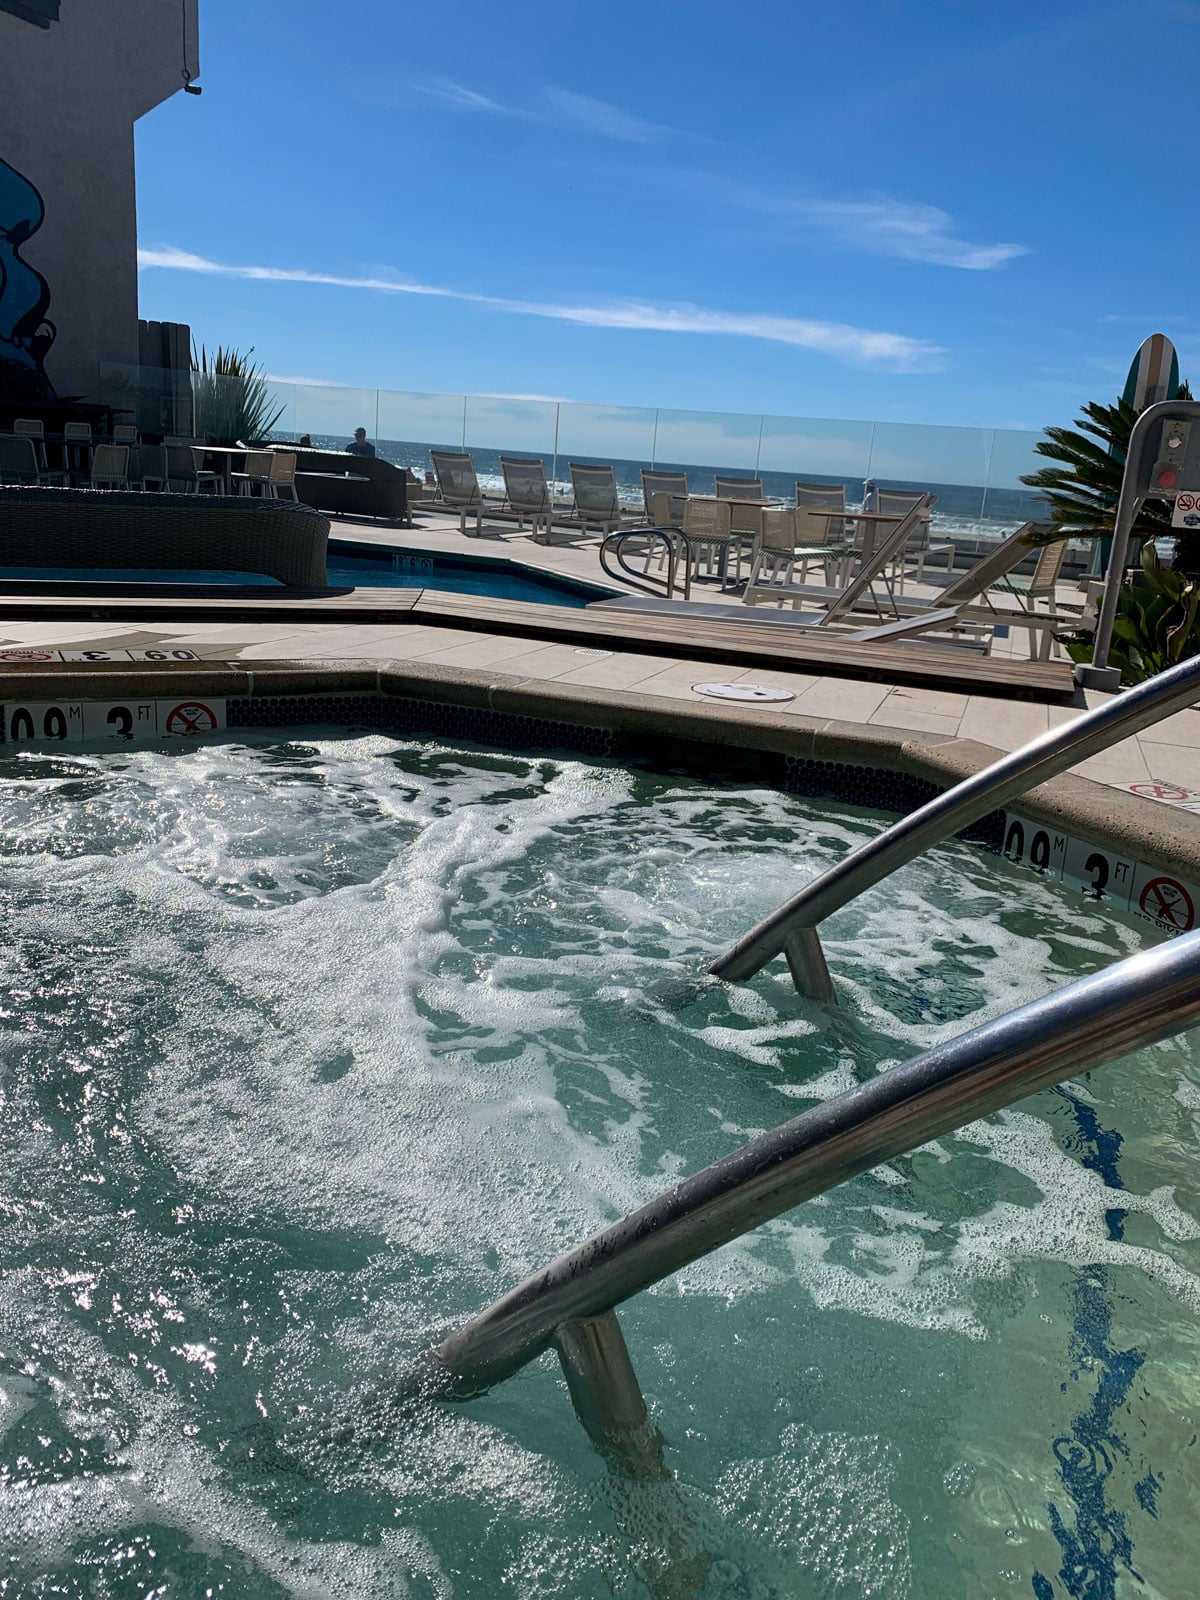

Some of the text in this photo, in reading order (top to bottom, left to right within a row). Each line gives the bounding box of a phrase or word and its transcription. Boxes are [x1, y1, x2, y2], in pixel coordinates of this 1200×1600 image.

[82, 651, 111, 661] 3
[69, 706, 81, 719] M
[138, 705, 151, 720] FT
[1053, 836, 1065, 853] M
[1081, 853, 1110, 900] 3
[1114, 861, 1130, 883] FT
